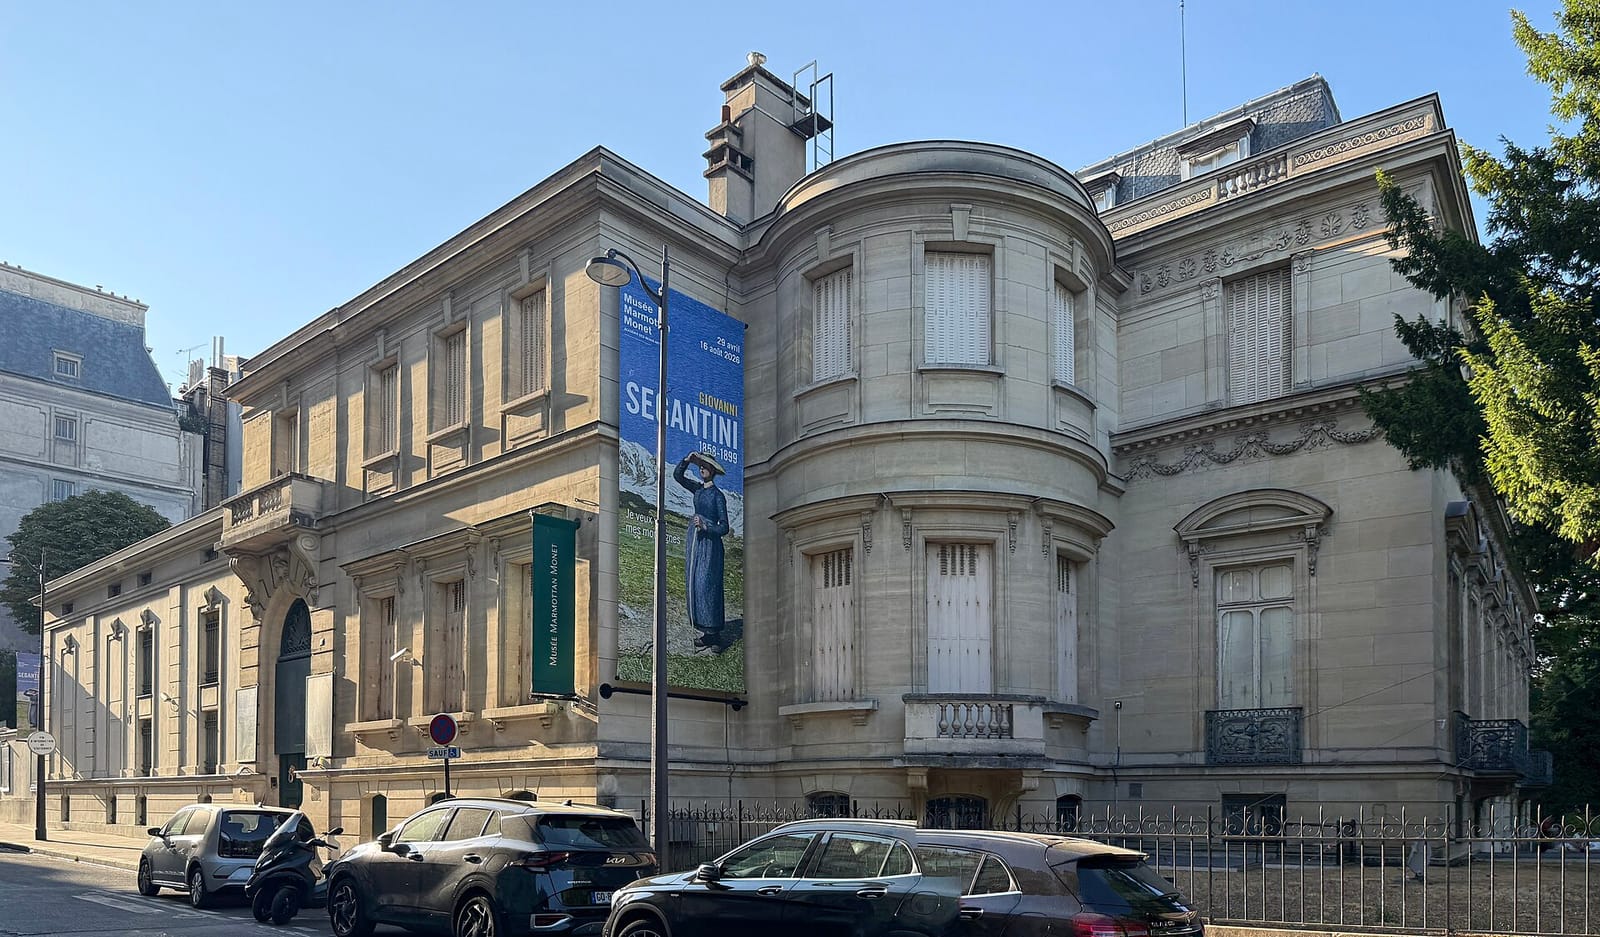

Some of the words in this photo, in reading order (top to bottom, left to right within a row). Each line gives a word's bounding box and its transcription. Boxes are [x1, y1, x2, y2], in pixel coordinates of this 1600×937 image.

[624, 293, 653, 313] Musée
[624, 315, 652, 335] Monet
[700, 340, 708, 350] 16
[709, 346, 723, 357] août
[724, 351, 741, 364] 2026
[717, 336, 726, 347] 29
[727, 342, 741, 353] avril
[699, 392, 738, 417] GIOVANNI
[699, 441, 738, 464] 1858-1899
[625, 508, 634, 520] Je
[635, 513, 653, 524] veux
[625, 524, 641, 535] mes
[428, 749, 447, 757] SAUF
